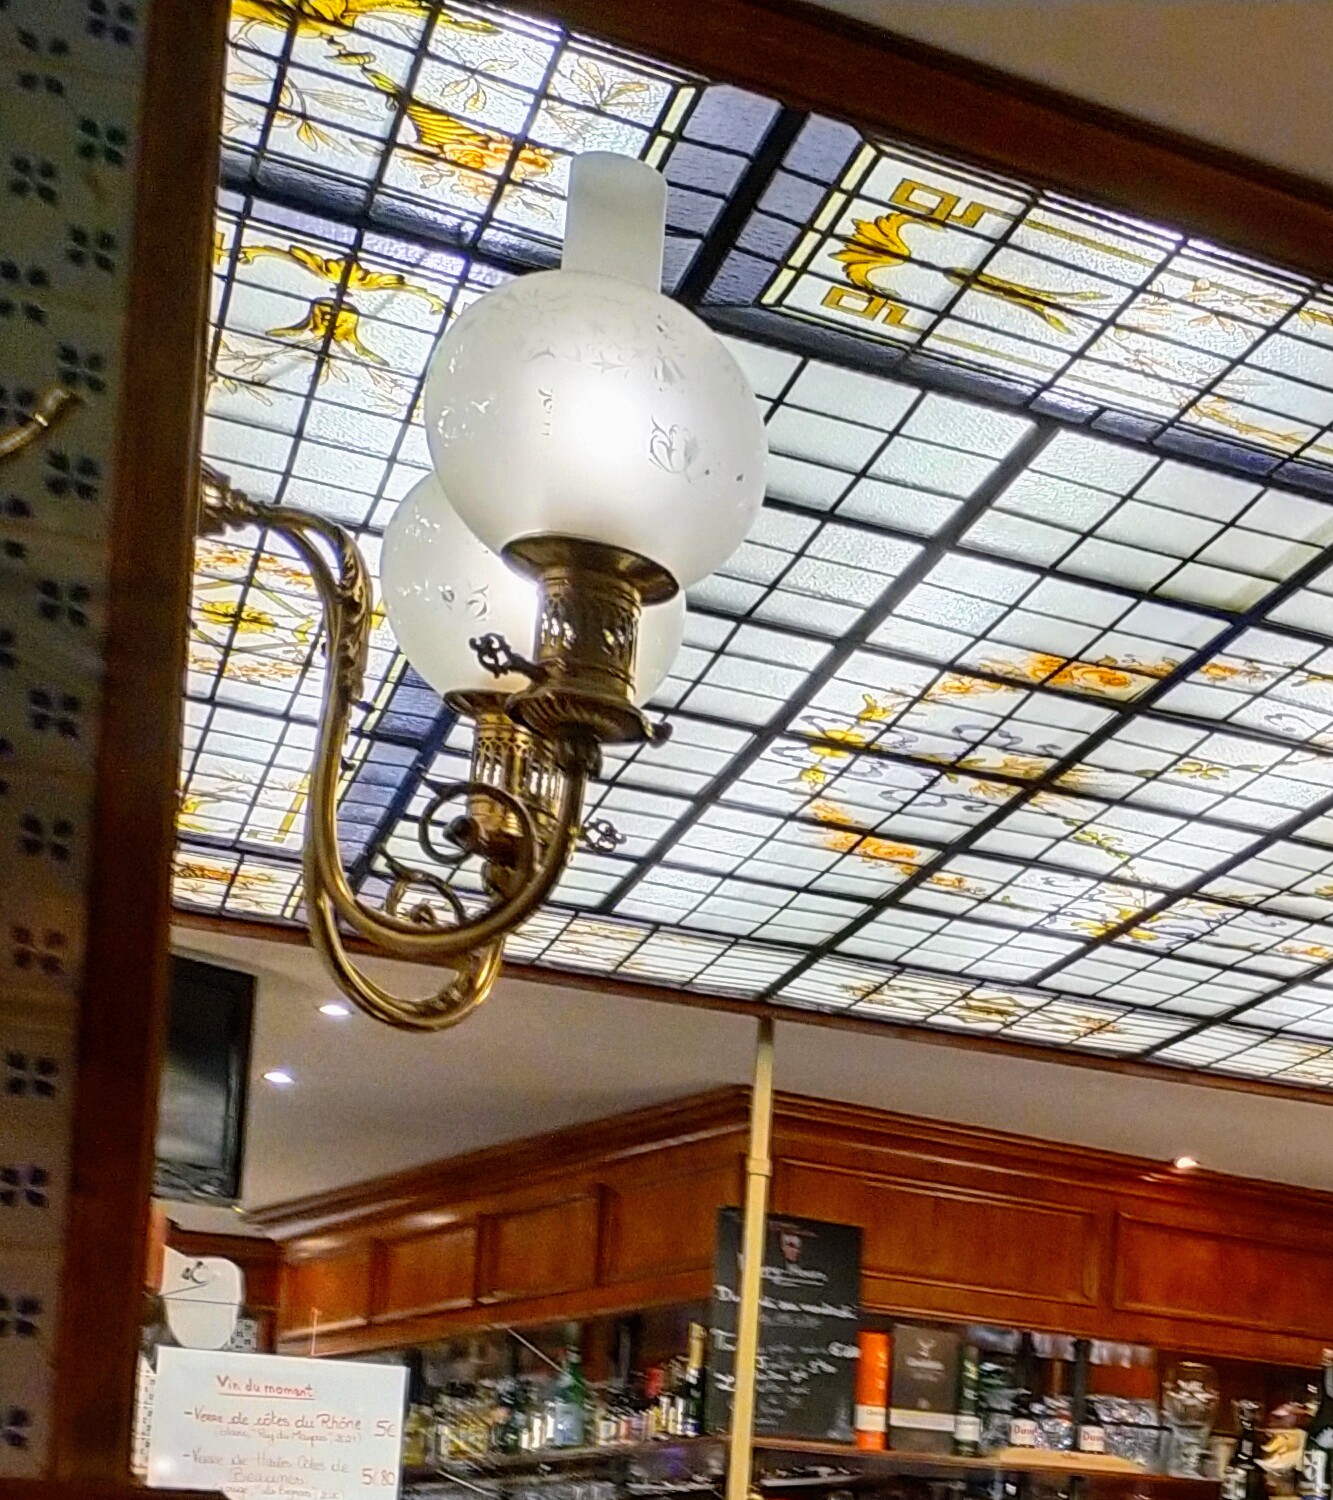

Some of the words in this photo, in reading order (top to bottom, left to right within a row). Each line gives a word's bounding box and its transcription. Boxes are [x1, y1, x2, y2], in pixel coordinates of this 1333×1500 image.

[216, 1375, 240, 1390] Vin
[246, 1378, 260, 1392] du
[264, 1383, 313, 1397] moment
[228, 1412, 249, 1426] de
[295, 1415, 315, 1428] du
